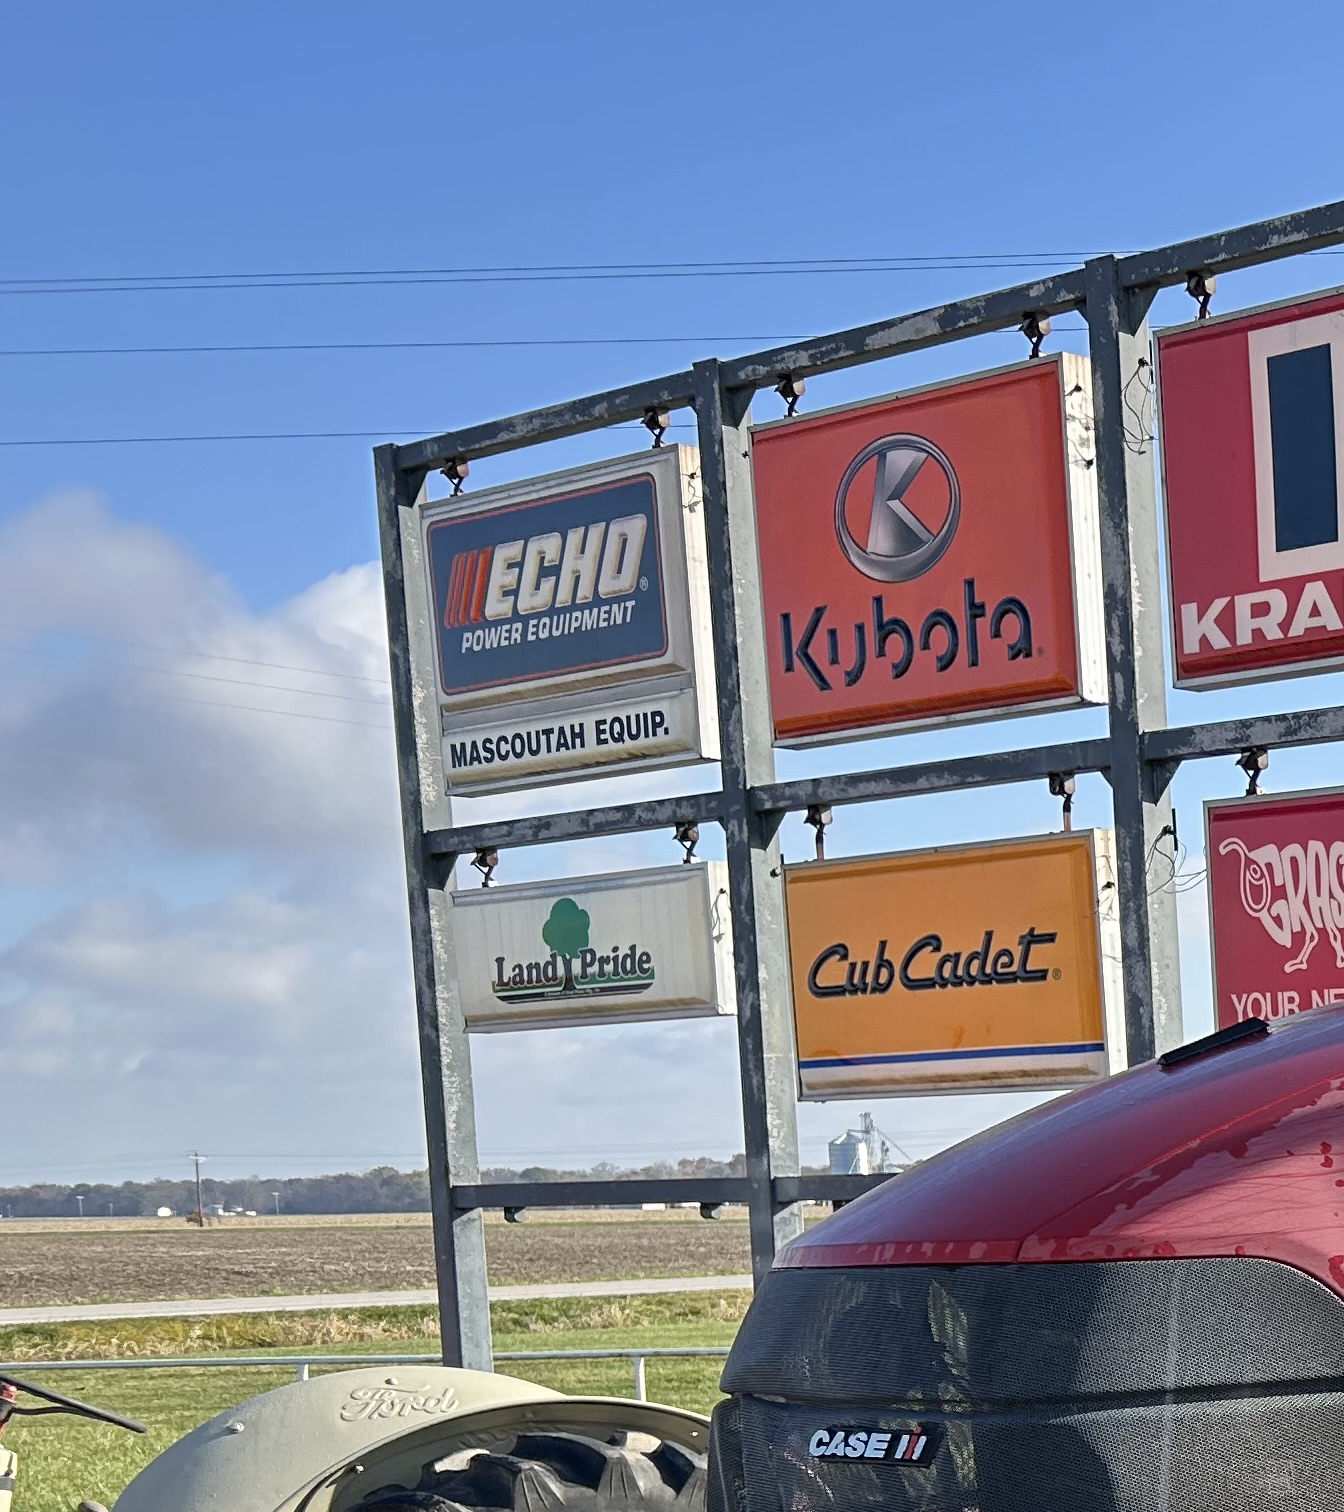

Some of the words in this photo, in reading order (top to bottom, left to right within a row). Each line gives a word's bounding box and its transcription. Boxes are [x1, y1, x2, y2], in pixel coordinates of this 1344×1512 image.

[483, 512, 649, 622] ECHO
[461, 621, 523, 655] POWER
[526, 599, 637, 643] EQUIPMENT
[779, 576, 1033, 692] Kubota
[449, 721, 586, 769] MASCOUTAH
[595, 709, 670, 746] EQUIP.
[494, 952, 559, 989] Land
[578, 943, 653, 981] Pride
[808, 939, 896, 999] Cub
[899, 926, 1058, 992] Cadet
[1230, 990, 1301, 1022] YOUR
[339, 1385, 460, 1423] Ford
[808, 1429, 892, 1459] CASE
